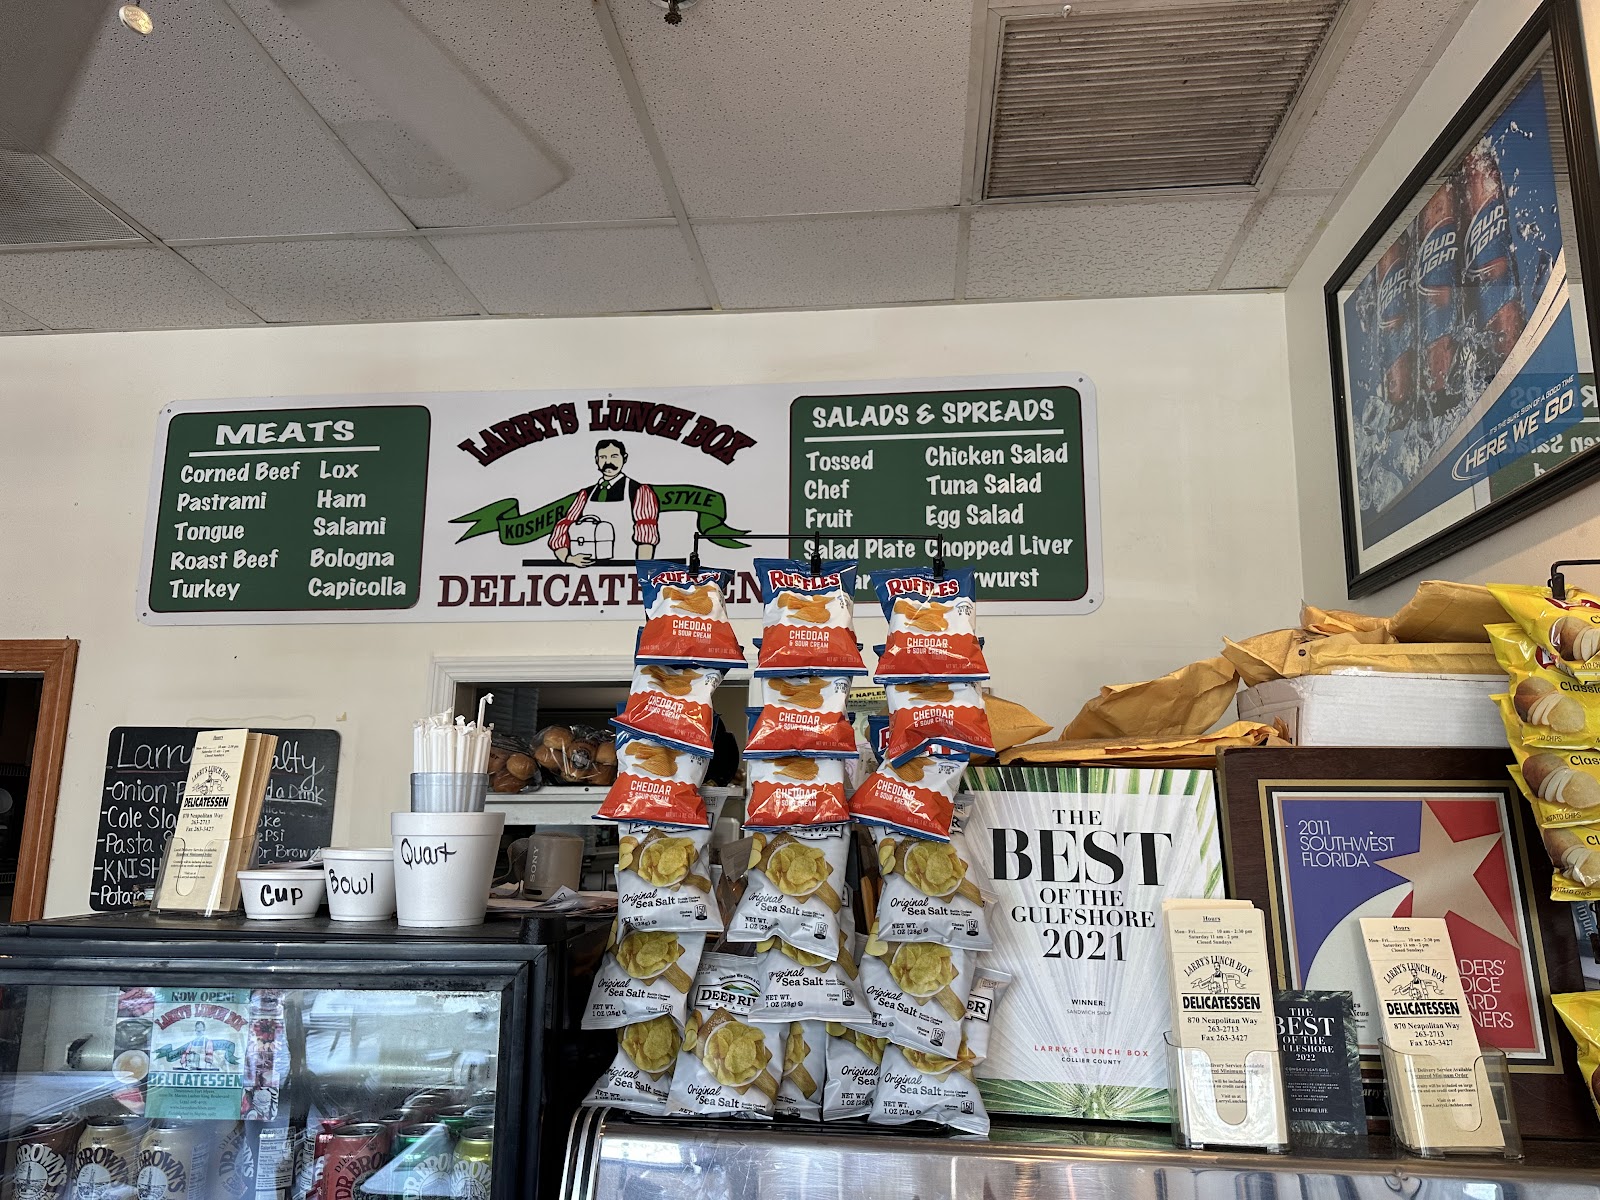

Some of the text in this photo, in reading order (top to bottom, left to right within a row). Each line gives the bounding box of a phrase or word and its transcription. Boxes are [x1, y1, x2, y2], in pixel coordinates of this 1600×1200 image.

[1470, 205, 1503, 244] BUD
[1423, 232, 1456, 261] BUD
[1498, 418, 1506, 430] THE
[1506, 412, 1520, 424] SURE
[1520, 403, 1533, 416] SIGN
[1533, 397, 1541, 407] OF
[1546, 383, 1561, 398] GOOD
[1562, 374, 1574, 388] TIME
[812, 399, 1054, 428] SALADS & SPREADS
[215, 420, 356, 446] MEATS
[457, 400, 757, 467] LARRY'S LUNCH BOX
[1465, 431, 1509, 472] HERE
[1512, 410, 1540, 443] WE
[806, 450, 874, 471] Tossed
[925, 443, 1068, 467] Chicken Salad
[181, 461, 300, 484] Corned Beef
[320, 462, 359, 479] Lox
[804, 479, 850, 500] Chef
[926, 473, 1041, 495] Tuna Salad
[176, 492, 267, 512] Pastrami
[317, 490, 366, 509] Ham
[504, 490, 713, 539] KOSHER STYLE
[806, 508, 853, 529] Fruit
[926, 504, 1024, 529] Egg Salad
[174, 522, 244, 544] Tongue
[313, 517, 386, 537] Salami
[804, 539, 916, 560] Salad Plate
[925, 535, 1073, 558] Chopped Liver
[171, 549, 279, 572] Roast Beef
[310, 548, 395, 572] Bologna
[170, 579, 240, 601] Turkey
[308, 577, 407, 600] Capicolla
[768, 570, 840, 593] RUFFLES
[886, 577, 959, 600] RUFFLES
[673, 620, 712, 632] CHEDDAR
[790, 630, 830, 641] CHEDDAR
[907, 637, 948, 648] CHEDDAR
[648, 695, 684, 713] CHEDDAR
[779, 712, 820, 724] CHEDDAR
[913, 709, 954, 720] CHEDDAR
[630, 781, 672, 795] CHEDDAR
[876, 780, 916, 800] CHEDDAR
[183, 797, 230, 808] DELICATESSEN
[147, 806, 178, 829] Sla
[1052, 809, 1102, 825] THE
[1298, 820, 1331, 835] 2011
[1300, 836, 1395, 851] SOUTHWEST
[401, 838, 457, 870] Quart
[530, 845, 540, 882] SONY
[988, 827, 1172, 886] BEST
[1302, 852, 1370, 868] FLORIDA
[328, 868, 374, 895] Bowl
[260, 883, 303, 907] Cup
[622, 889, 657, 908] Original
[656, 897, 675, 906] Salt
[890, 897, 929, 912] Original
[1039, 887, 1124, 907] OF THE
[908, 907, 926, 915] Sea
[928, 907, 948, 915] Salt
[1011, 906, 1155, 928] GULFSHORE
[1042, 928, 1127, 962] 2021
[1184, 955, 1252, 977] LARRY'S LUNCH BOX
[1384, 963, 1448, 984] LARRY'S LUNCH BOX
[1458, 959, 1506, 976] DERS'
[598, 978, 631, 992] Original
[626, 989, 645, 998] Salt
[867, 986, 903, 1001] Original
[1462, 976, 1502, 993] OICE
[171, 992, 197, 1002] NOW
[701, 990, 735, 1003] DEEP
[1183, 996, 1260, 1009] DELICATESSEN
[1467, 994, 1498, 1010] ARD
[878, 998, 917, 1017] Sea Salt
[1289, 1008, 1313, 1016] THE
[1386, 1002, 1460, 1016] DELICATESSEN
[1275, 1017, 1334, 1036] BEST
[1471, 1012, 1514, 1028] NERS
[1034, 1045, 1078, 1053] LARRY'S
[1283, 1036, 1326, 1045] OF THE
[1283, 1045, 1334, 1053] ULFSHORE
[148, 1073, 243, 1087] DELICATESSEN
[884, 1073, 922, 1089] Original
[687, 1084, 722, 1100] Original
[900, 1085, 918, 1094] Sea
[920, 1086, 942, 1096] Salt
[698, 1095, 739, 1108] Sea Salt
